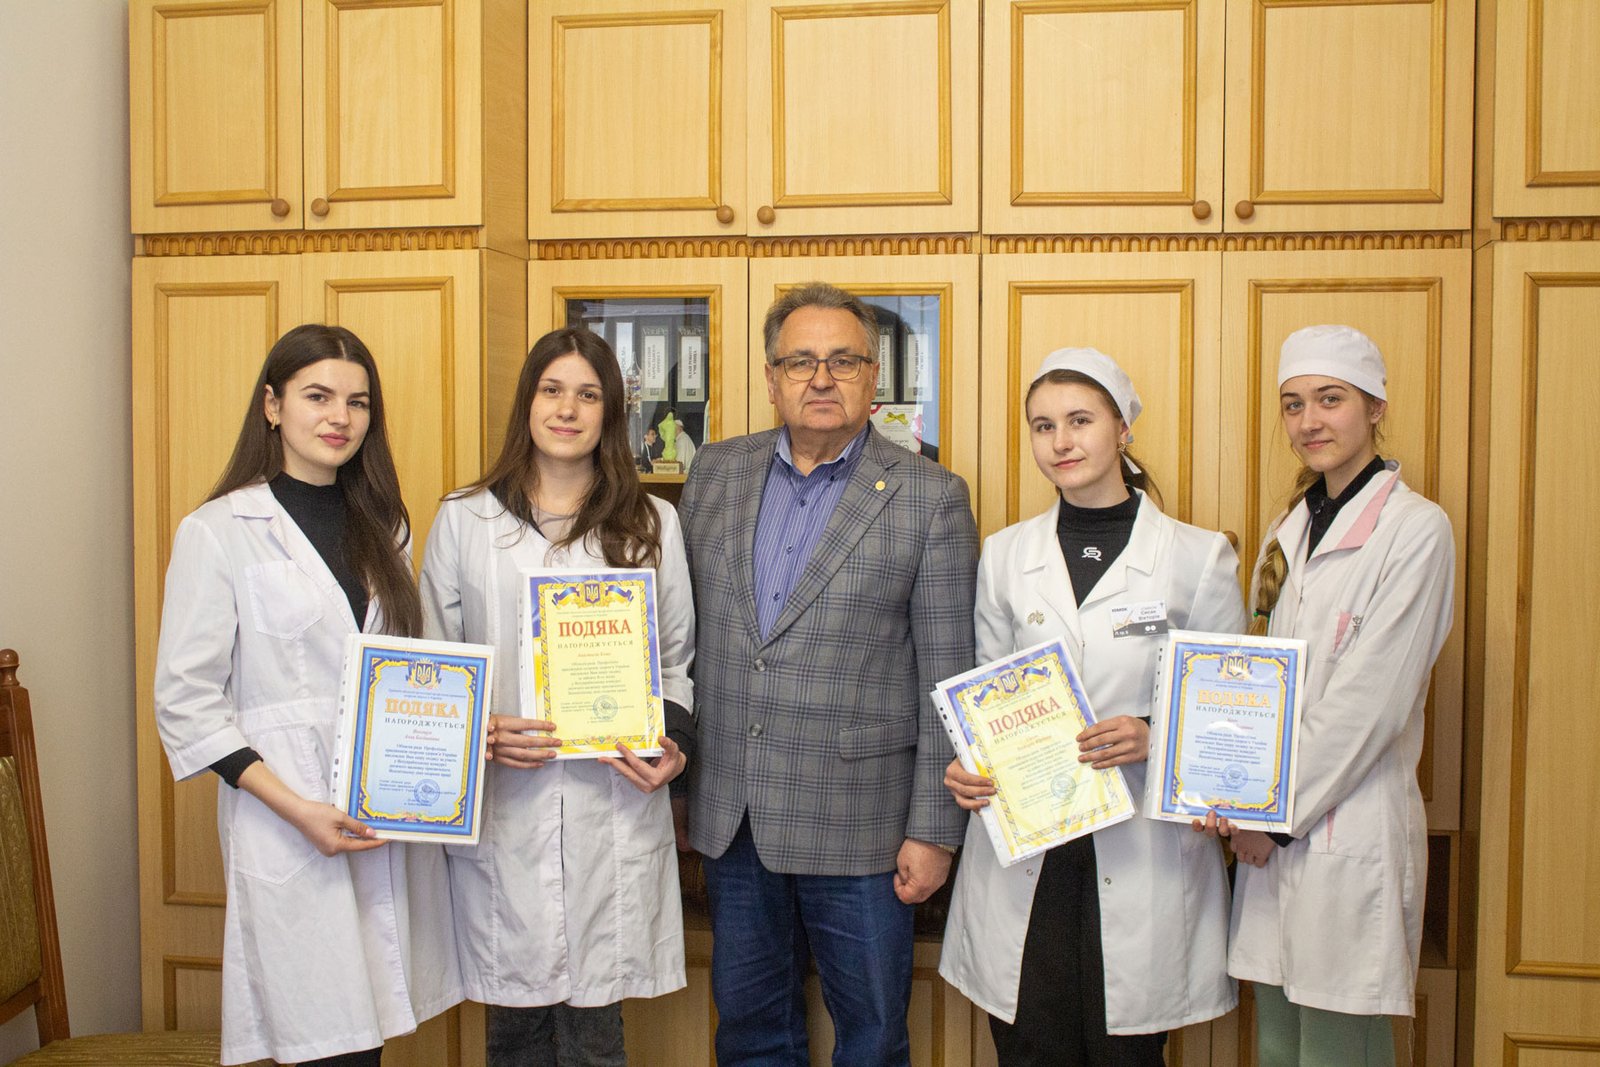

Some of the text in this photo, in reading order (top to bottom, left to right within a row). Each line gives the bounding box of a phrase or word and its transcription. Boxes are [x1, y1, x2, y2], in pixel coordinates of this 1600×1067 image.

[558, 619, 632, 639] ПОДЯКА
[385, 697, 460, 718] ПОДЯКА
[1197, 689, 1271, 708] ПОДЯКА
[988, 696, 1062, 737] ПОДЯКА
